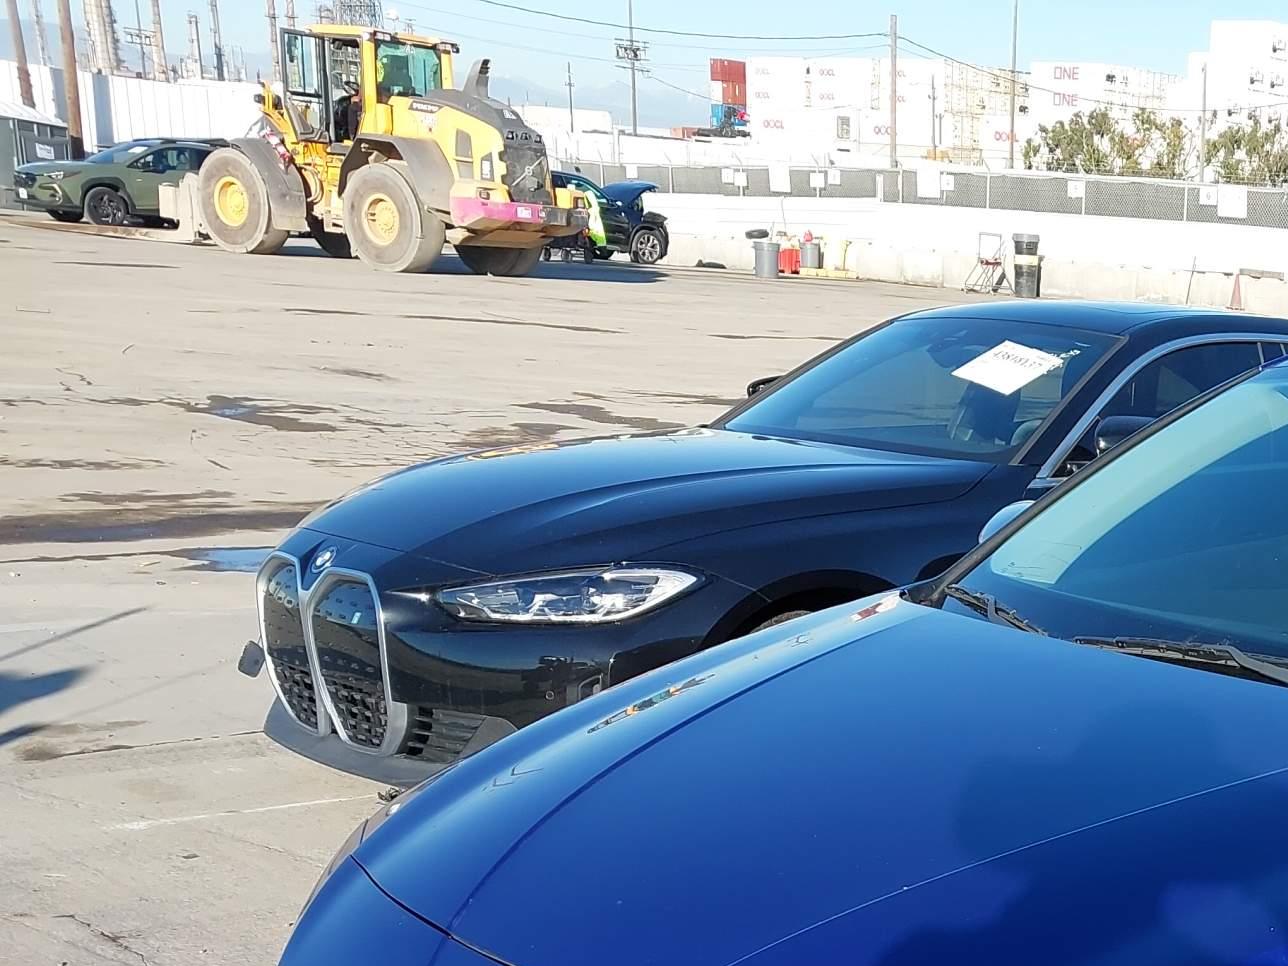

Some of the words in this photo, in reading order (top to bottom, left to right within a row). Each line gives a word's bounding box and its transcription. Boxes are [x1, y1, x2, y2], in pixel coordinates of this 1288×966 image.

[1053, 66, 1080, 80] ONE
[1053, 92, 1079, 107] ONE
[763, 119, 785, 129] OOCL
